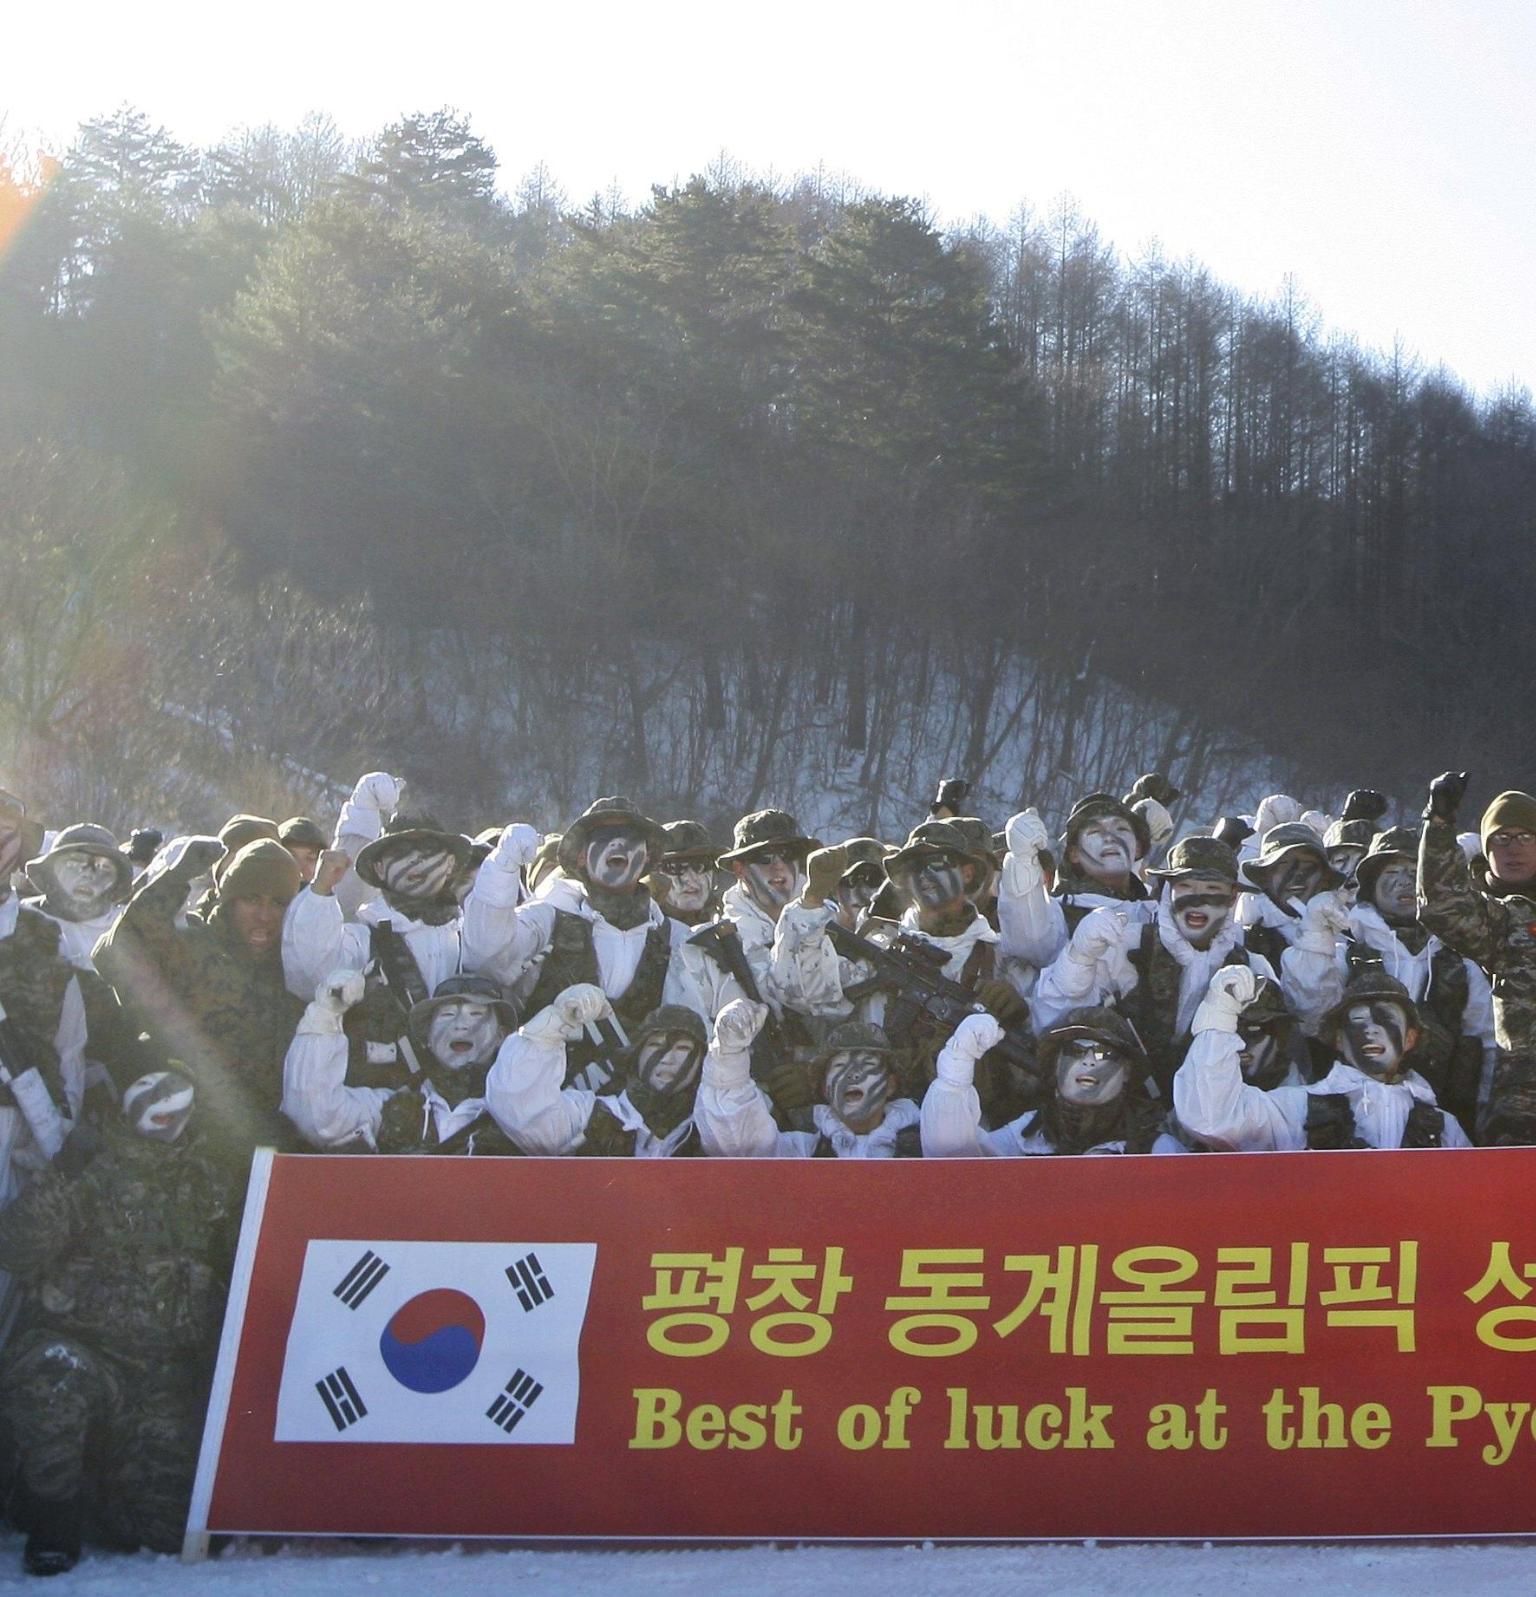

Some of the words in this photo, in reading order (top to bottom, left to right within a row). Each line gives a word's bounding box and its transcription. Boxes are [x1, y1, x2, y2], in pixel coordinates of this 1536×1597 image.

[641, 1245, 854, 1358] 평창
[884, 1240, 1419, 1358] 동계올림픽
[627, 1387, 803, 1451] Best
[836, 1387, 922, 1451] of
[943, 1387, 1115, 1451] luck
[1146, 1388, 1228, 1451] at
[1262, 1386, 1392, 1450] the
